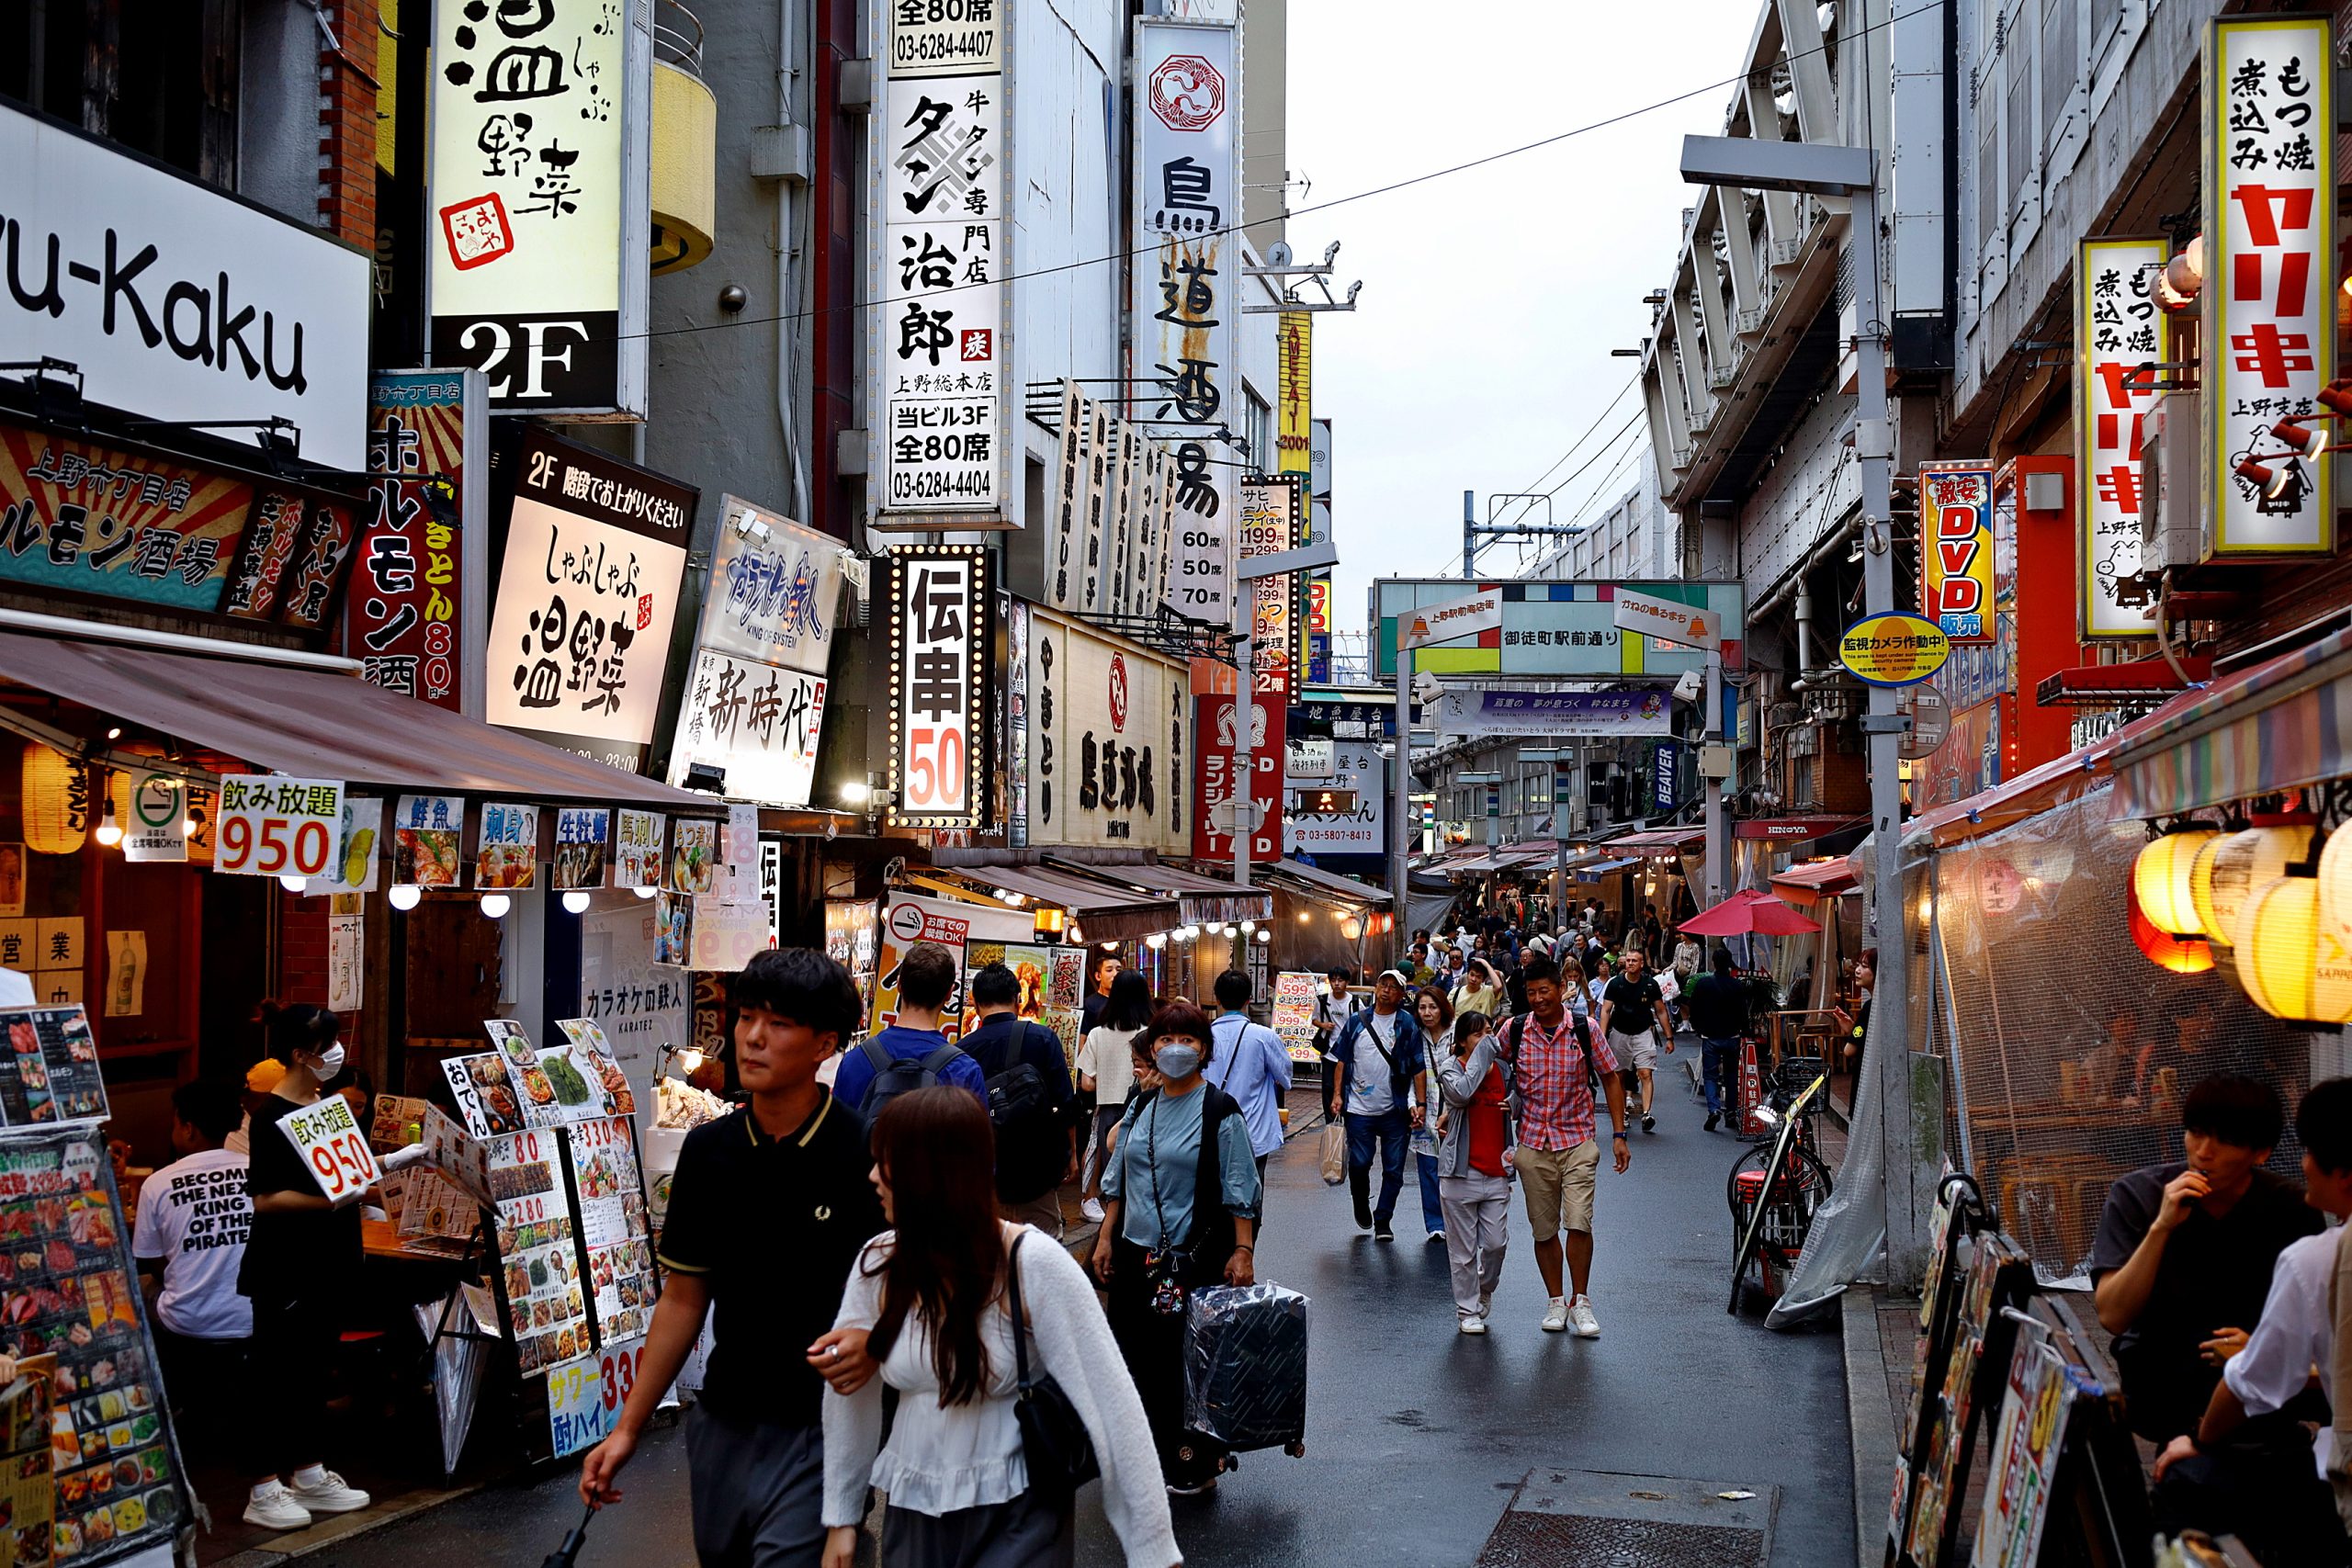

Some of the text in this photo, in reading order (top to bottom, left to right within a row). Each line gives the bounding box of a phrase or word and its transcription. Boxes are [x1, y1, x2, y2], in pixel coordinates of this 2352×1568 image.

[897, 30, 993, 62] 03-6284-4407
[2231, 59, 2270, 170] 煮込み
[2274, 55, 2315, 172] もつ焼
[960, 89, 991, 285] 牛タン専門店
[896, 95, 958, 367] タン治郎
[0, 214, 308, 397] u-Kaku
[2094, 268, 2123, 352] 煮込み
[2125, 266, 2157, 355] もつ焼
[459, 321, 589, 398] 2F
[963, 332, 989, 360] 炭
[894, 373, 993, 395] 上野総本店
[1288, 324, 1301, 432] AMECAJI
[896, 405, 989, 430] 当ビル3F
[2231, 398, 2314, 418] 上野支店
[894, 433, 990, 464] 全80席
[1280, 434, 1309, 451] 2001
[28, 446, 192, 512] 上野六丁目店
[527, 450, 684, 529] 2F 階段でお上がりください
[893, 469, 990, 499] 03-6284-4404
[1935, 477, 1980, 505] 激安
[1182, 531, 1221, 548] 60席
[546, 524, 640, 599] しゃぶしゃぶ
[1182, 559, 1223, 577] 50席
[1936, 504, 1981, 614] DVD
[725, 544, 823, 641] カラオケの鉄人
[1000, 600, 1009, 618] 4F
[1182, 589, 1221, 604] 70席
[1430, 598, 1496, 625] 上野駅前商店街
[1621, 599, 1688, 625] かねの鳴るまち
[1939, 613, 1982, 637] 販売
[746, 623, 763, 641] KING
[773, 632, 797, 650] SYSTEM
[910, 567, 965, 723] 伝串
[1503, 629, 1619, 648] 御徒町駅前通り
[1843, 637, 1946, 651] 監視カメラ作動中!
[513, 594, 636, 717] 温野菜
[701, 655, 716, 672] 東京
[1259, 673, 1284, 693] 2階
[689, 677, 711, 746] 新橋
[707, 659, 812, 756] 新時代
[1039, 636, 1054, 825] やきとり
[907, 728, 964, 806] 50
[1080, 729, 1156, 818] 鳥道酒場
[1657, 748, 1673, 807] BEAVER
[222, 779, 339, 818] 飲み放題
[410, 796, 450, 829] 鮮魚
[483, 807, 525, 845] 刺身
[618, 811, 662, 848] 馬刺し
[1308, 829, 1372, 841] 03-5807-8413
[1768, 826, 1808, 834] HINOYA
[221, 816, 330, 875] 950
[923, 928, 965, 943] 喫煙OK!
[926, 916, 966, 932] お席での
[1055, 953, 1073, 992] 伝串
[586, 982, 684, 1019] カラオケの鉄人
[1054, 995, 1069, 1007] 50
[617, 1018, 653, 1034] KARATEZ
[447, 1062, 488, 1138] おでん
[289, 1101, 354, 1147] 飲み放題
[582, 1121, 612, 1148] 330
[311, 1133, 374, 1195] 950
[514, 1132, 539, 1165] 80
[169, 1189, 206, 1208] THE
[193, 1197, 245, 1218] KING
[514, 1197, 544, 1224] 280
[189, 1216, 216, 1235] OF
[549, 1366, 602, 1410] サワー
[552, 1401, 602, 1453] 酎ハイ
